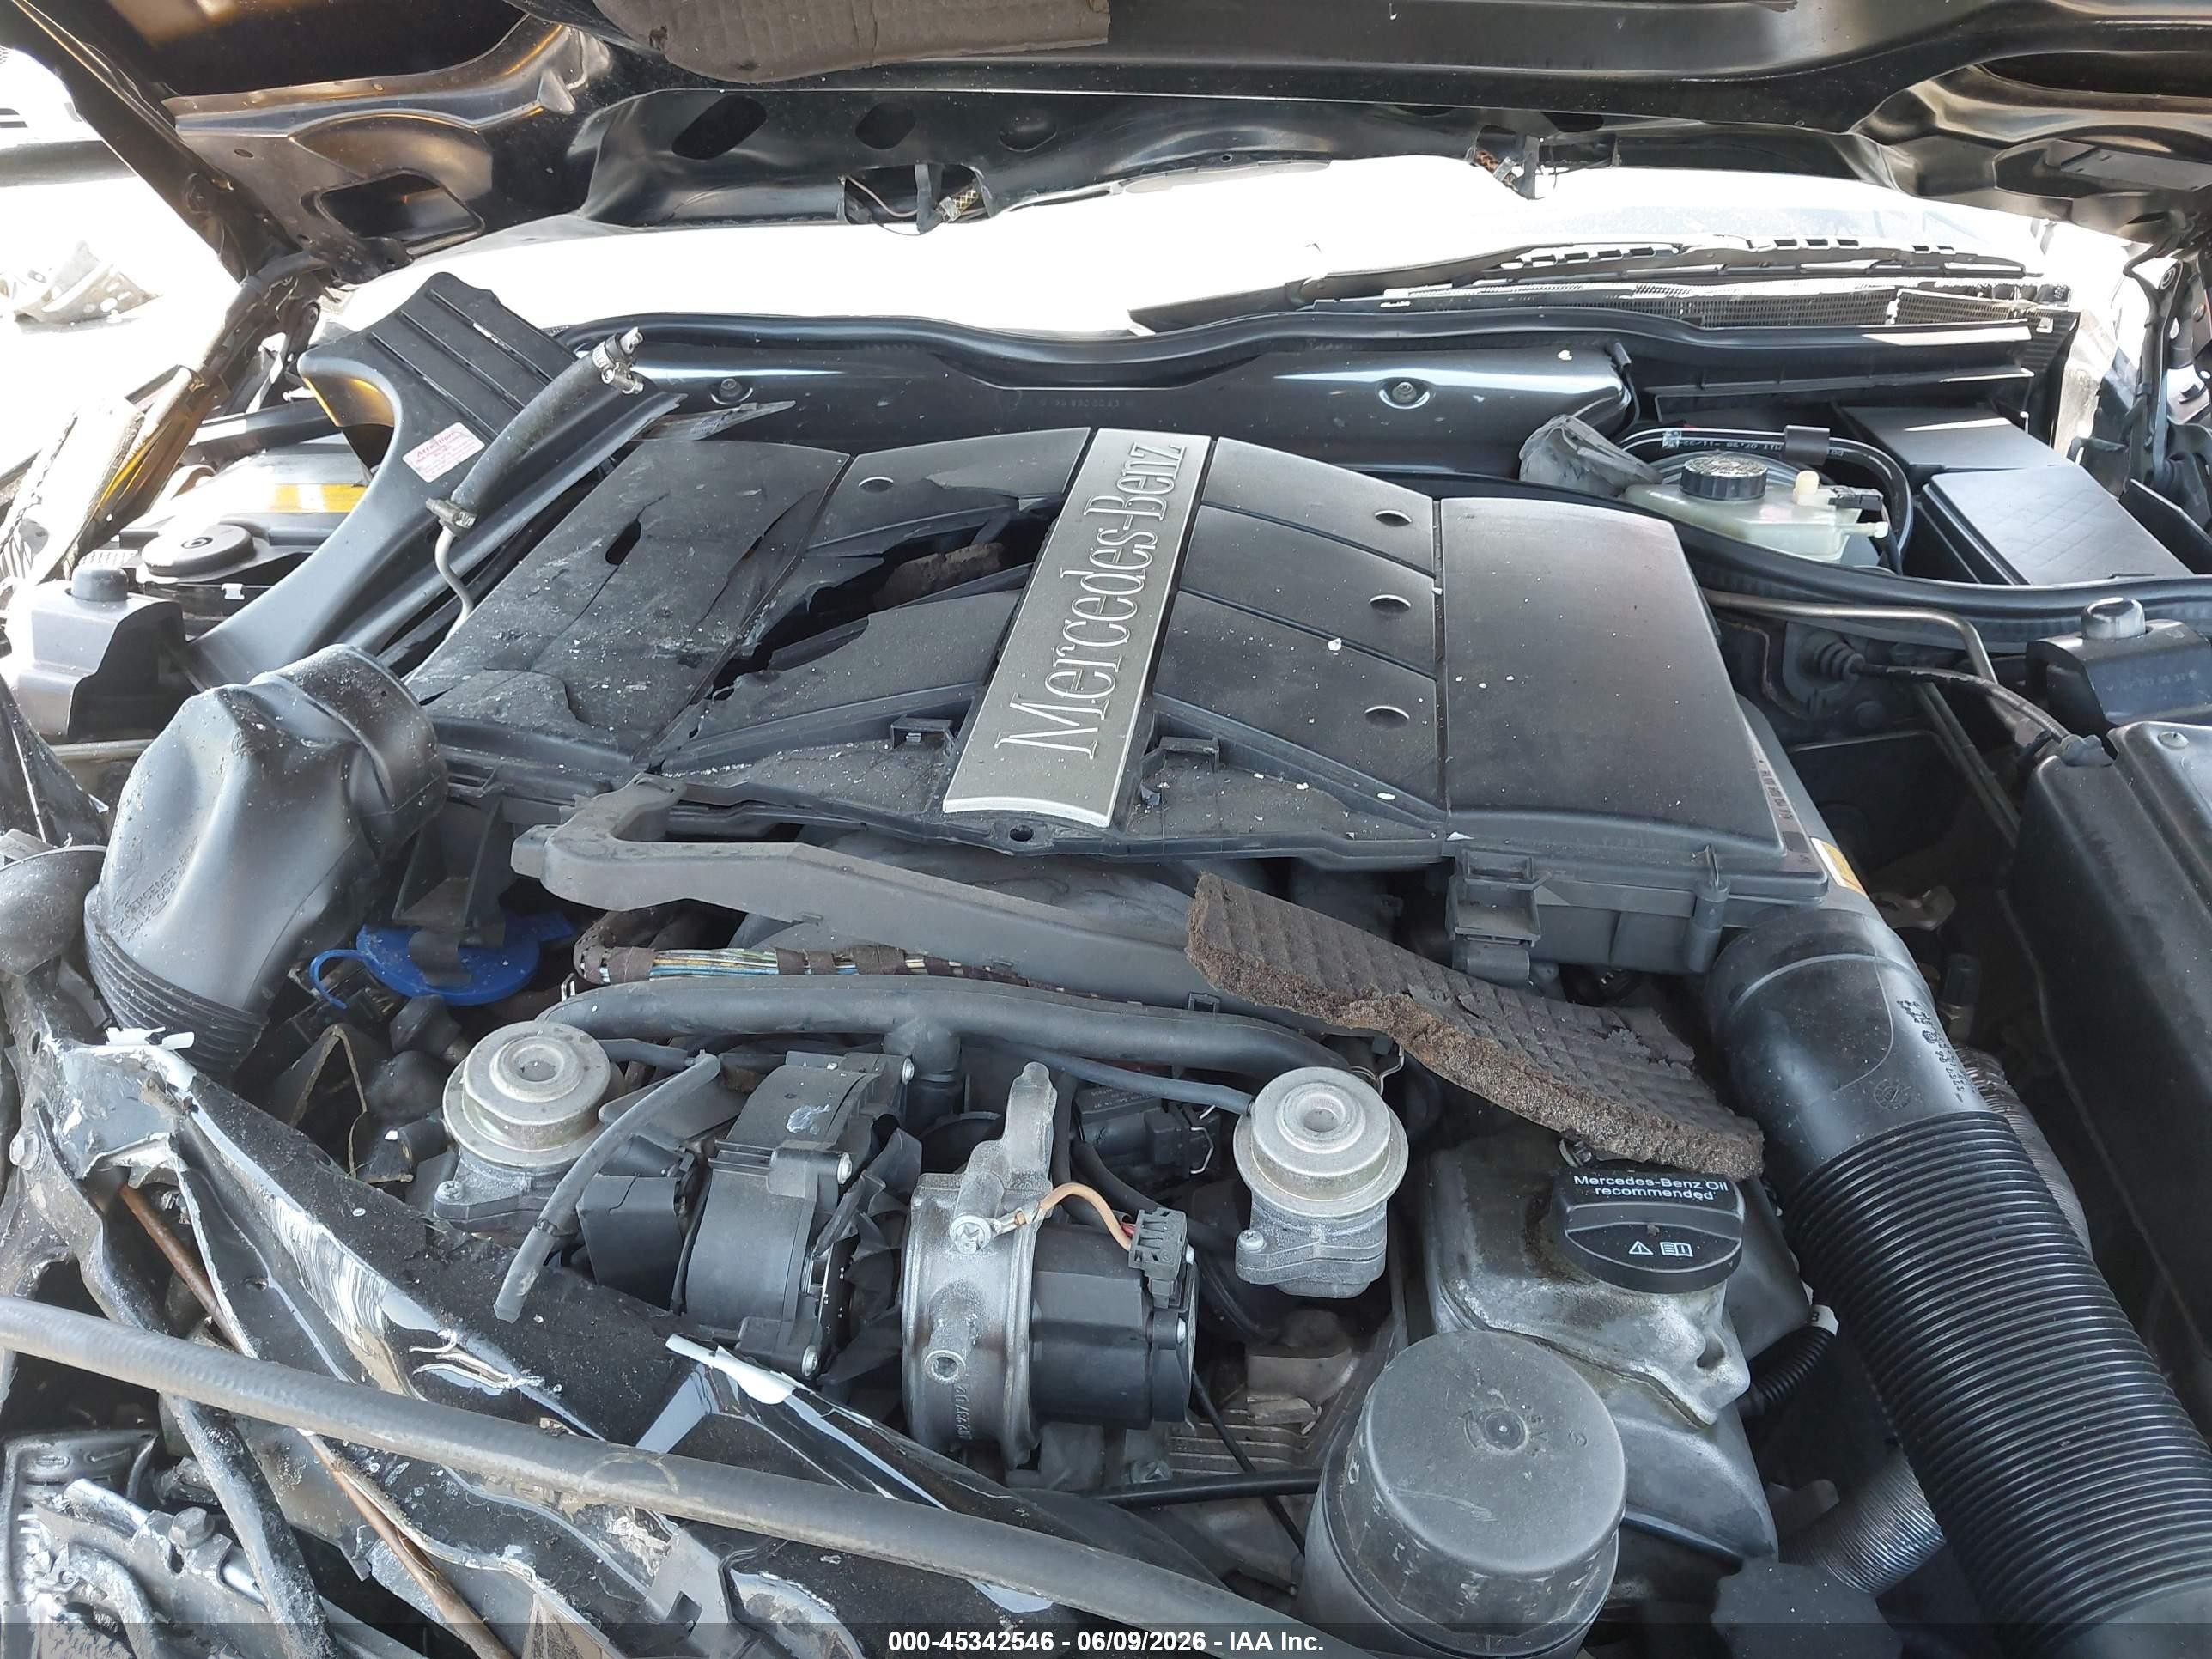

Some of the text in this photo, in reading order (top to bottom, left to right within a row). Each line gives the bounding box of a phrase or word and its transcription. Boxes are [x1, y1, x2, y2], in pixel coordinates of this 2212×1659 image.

[994, 441, 1187, 759] Mercedes-Benz
[1573, 1176, 1729, 1192] Mercedes-Benz Oil
